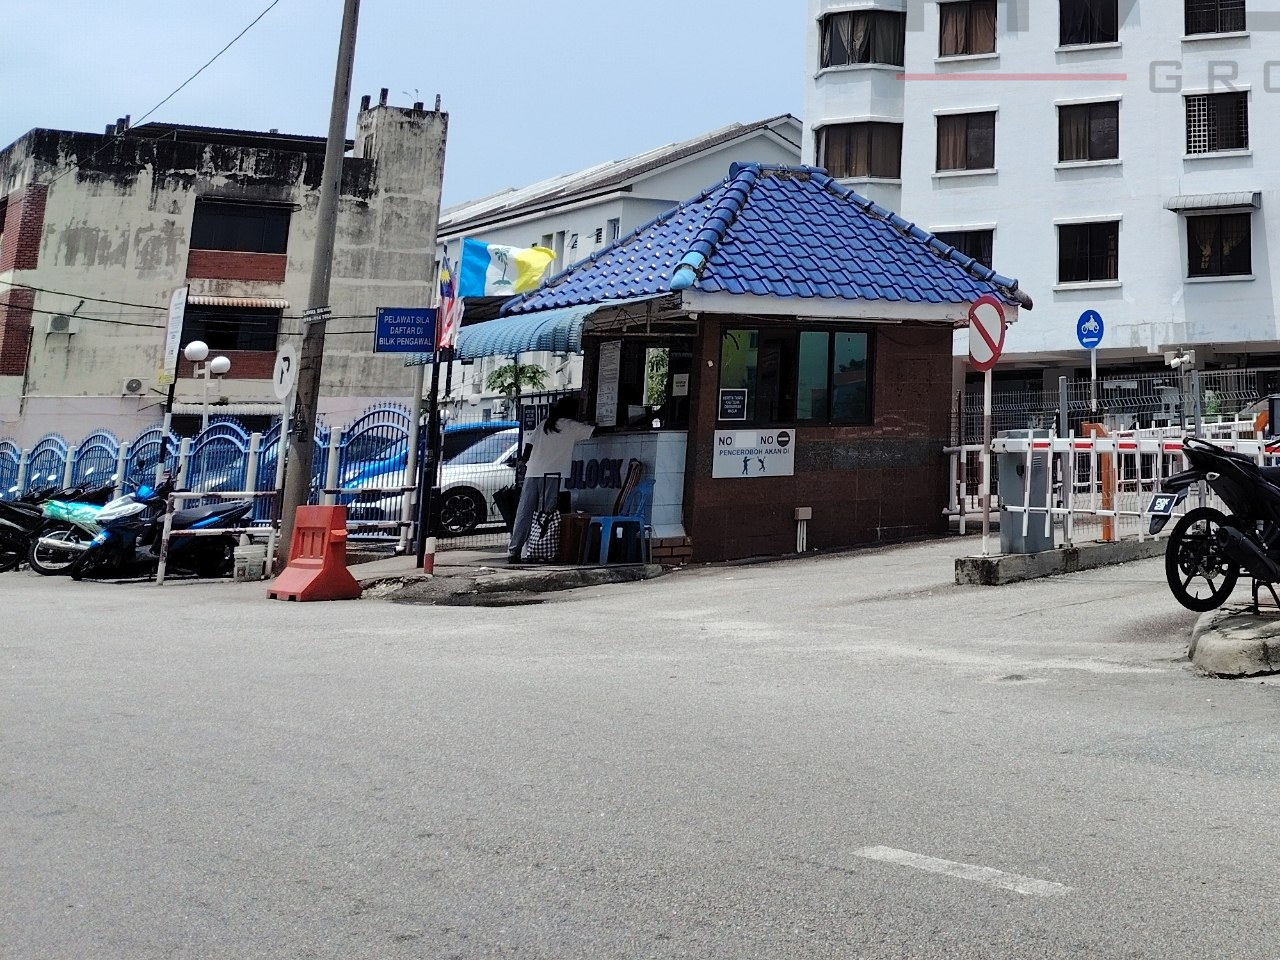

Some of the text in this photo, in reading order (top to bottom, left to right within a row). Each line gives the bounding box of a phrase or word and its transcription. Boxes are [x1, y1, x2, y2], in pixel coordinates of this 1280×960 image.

[384, 315, 430, 324] PELAWAT SILA
[390, 326, 424, 335] DAFTAR DI
[379, 337, 433, 346] BILIK PENGAWAL
[718, 435, 774, 446] NO NO
[720, 448, 763, 456] PENCEROBOH
[764, 447, 782, 455] AKAN
